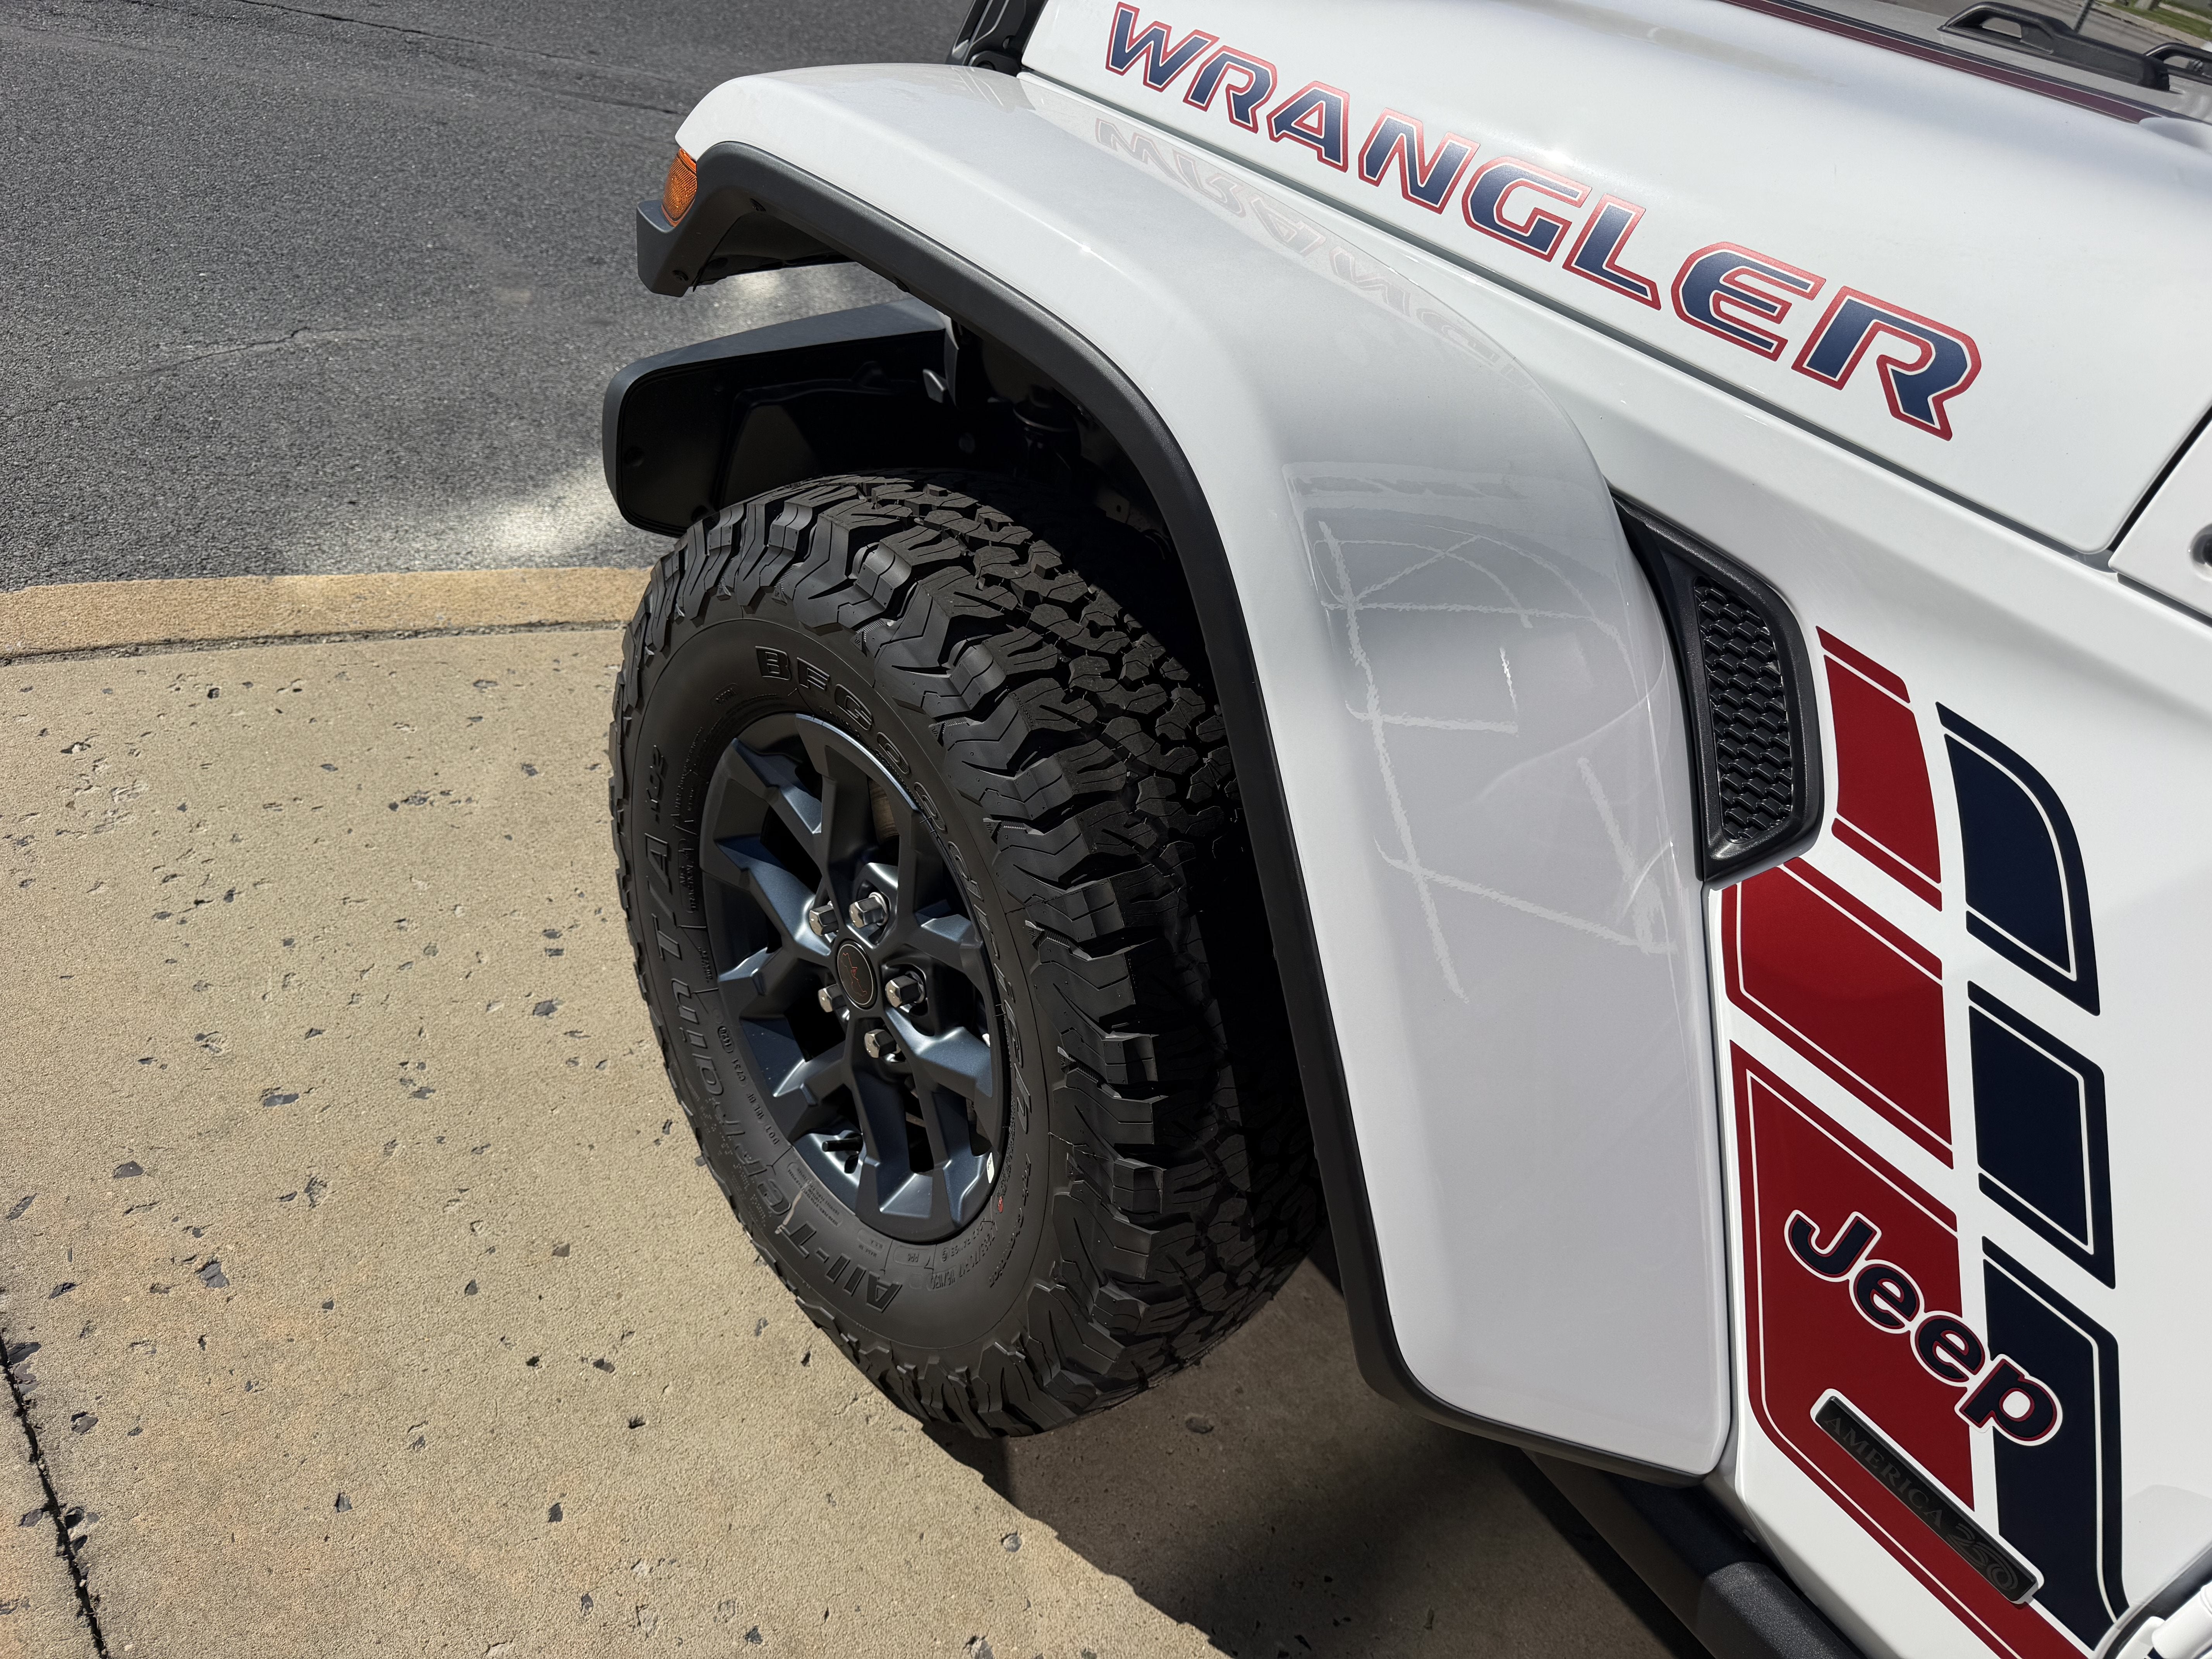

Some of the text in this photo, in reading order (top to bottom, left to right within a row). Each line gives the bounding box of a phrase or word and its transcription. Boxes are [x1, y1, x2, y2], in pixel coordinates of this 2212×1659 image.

[1105, 2, 1982, 441] WRANGLER
[1784, 1210, 2063, 1446] Jeep
[1823, 1414, 2019, 1592] AMERICA 250
